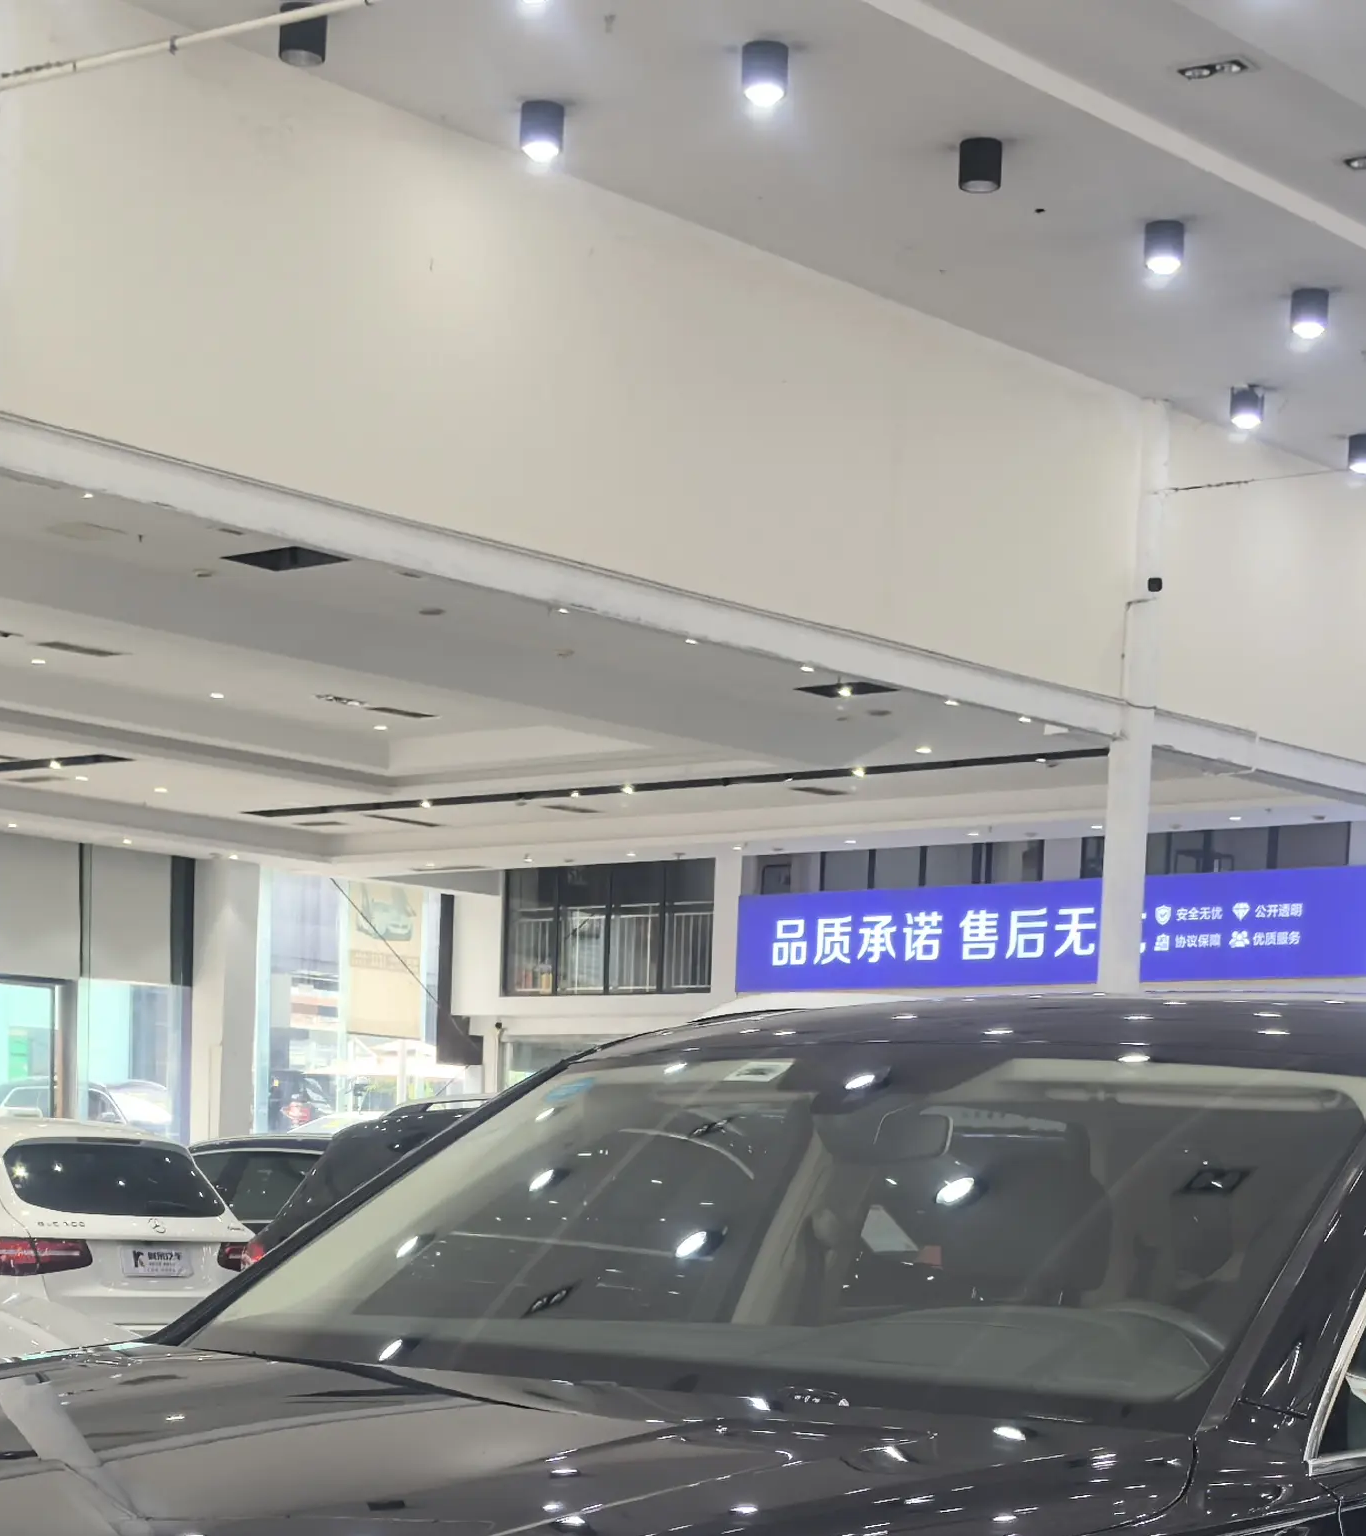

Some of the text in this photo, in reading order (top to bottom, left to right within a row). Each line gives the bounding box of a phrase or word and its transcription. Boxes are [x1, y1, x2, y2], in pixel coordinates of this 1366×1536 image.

[1176, 902, 1303, 922] 安全无忧 公开透明
[771, 905, 1146, 967] 品质承诺 售后无
[1174, 930, 1301, 949] 协议保障 优质服务
